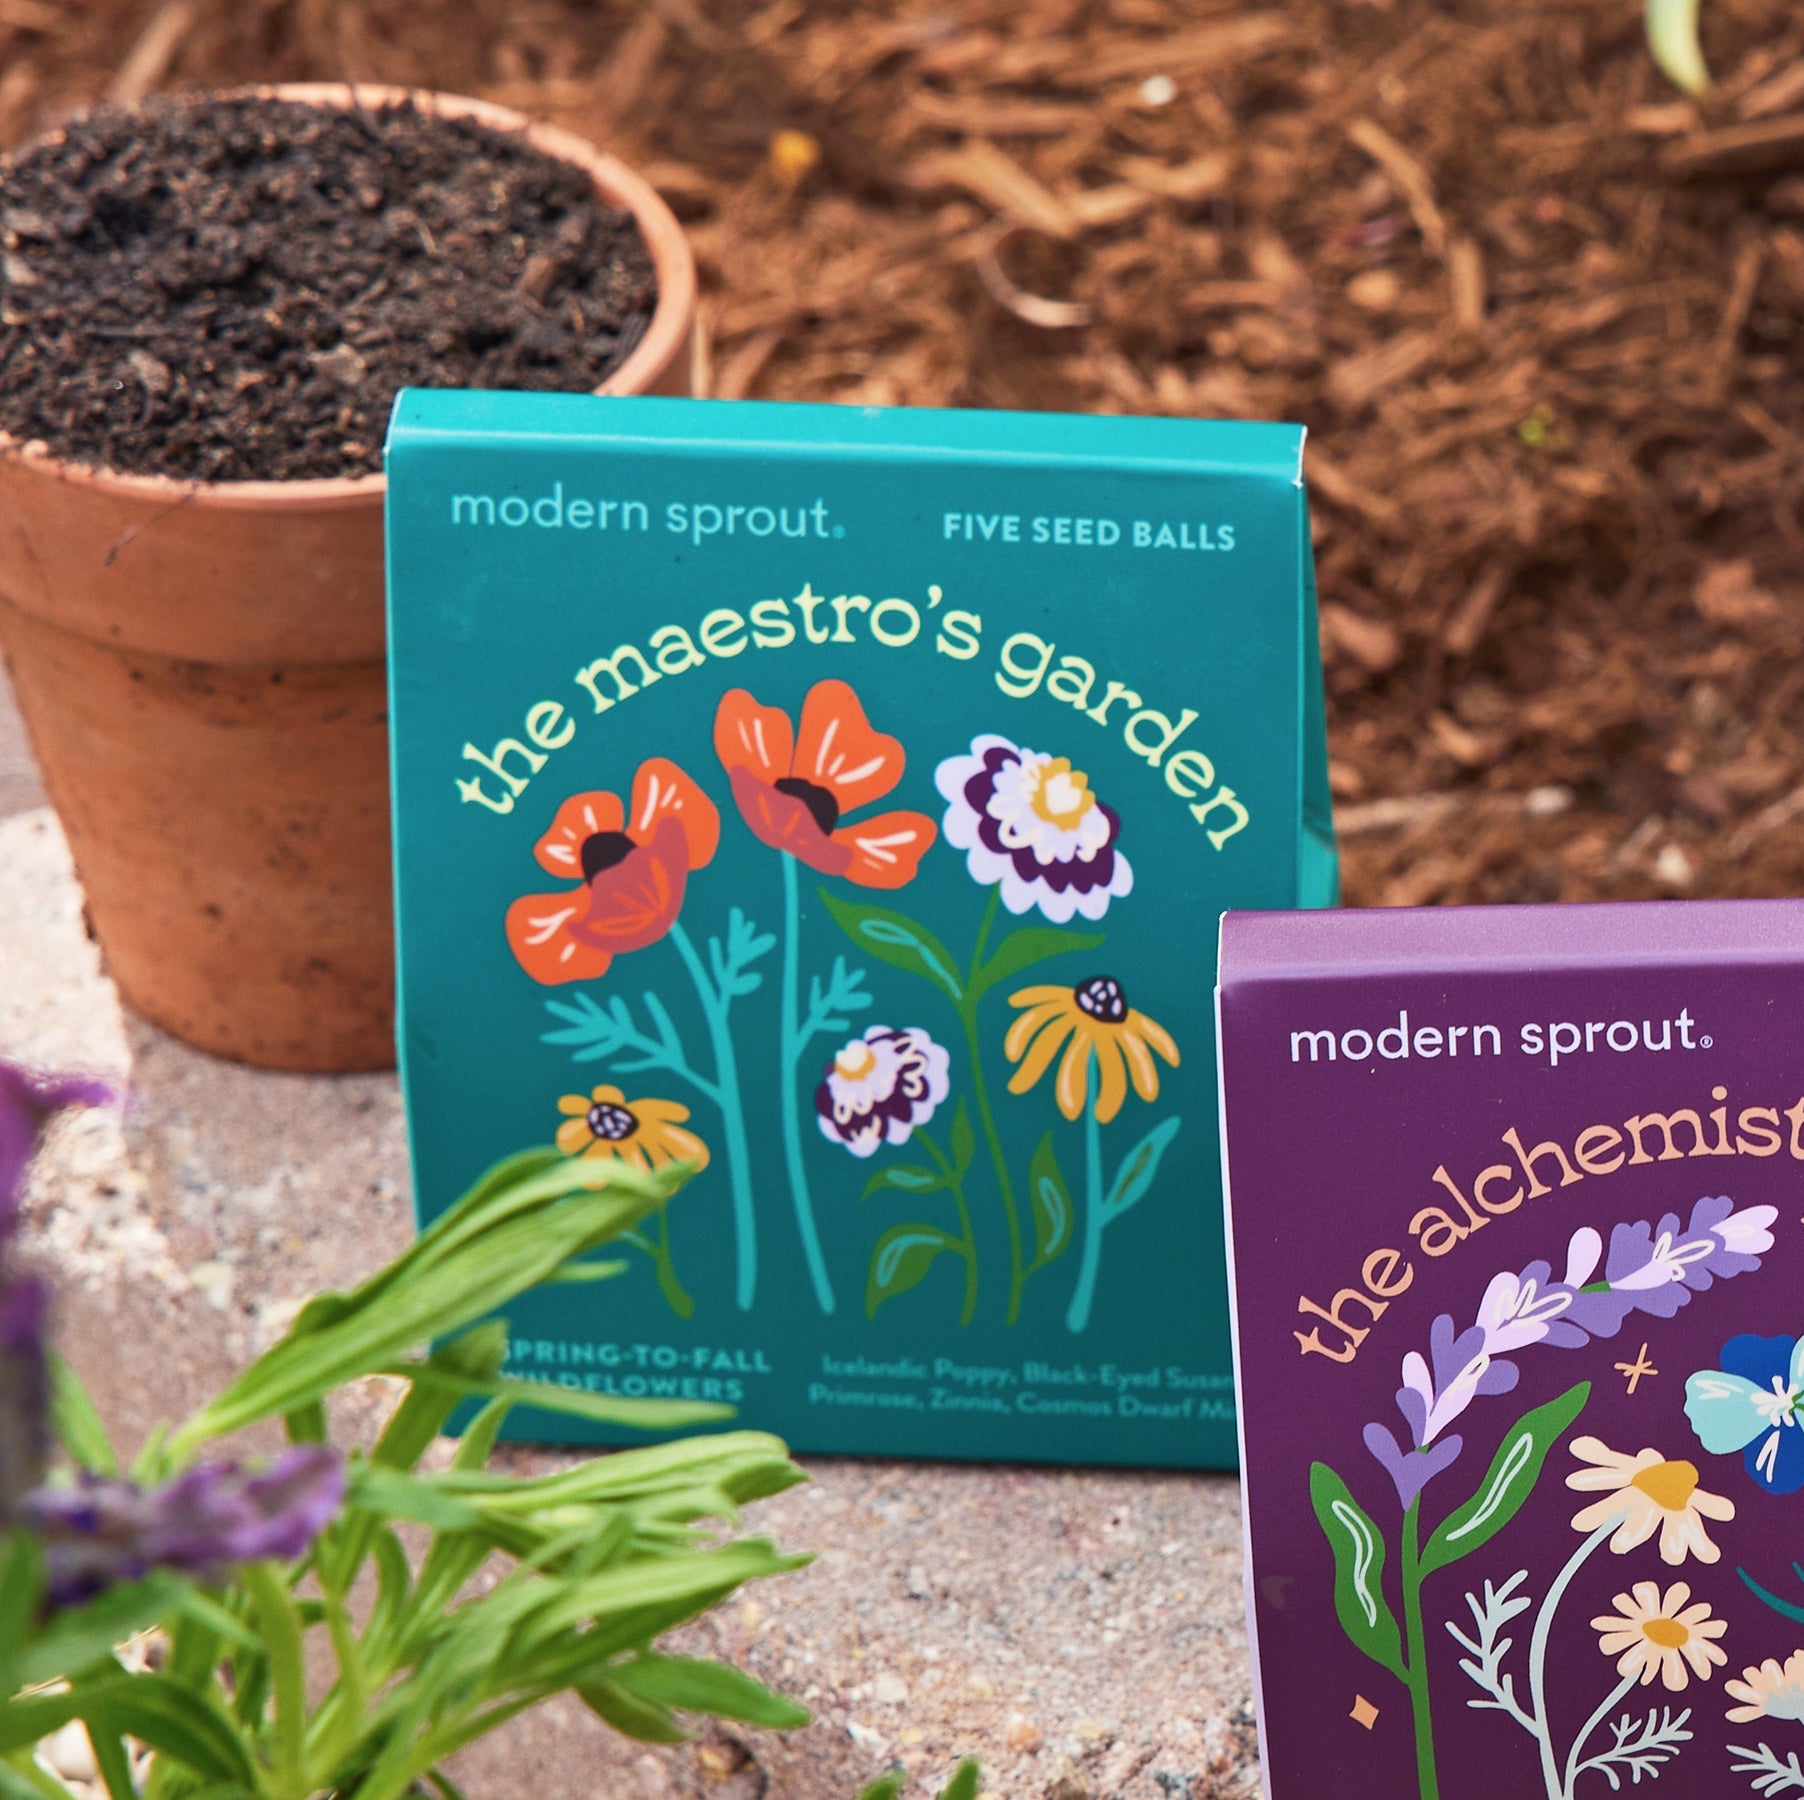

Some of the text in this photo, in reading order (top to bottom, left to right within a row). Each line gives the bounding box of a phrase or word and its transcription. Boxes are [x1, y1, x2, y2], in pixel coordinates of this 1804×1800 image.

[451, 480, 649, 532] modern
[943, 512, 1236, 551] FIVE SEED BALLS
[456, 582, 1250, 852] the maestro’s garden
[1290, 1010, 1501, 1062] modern
[1293, 1249, 1414, 1364] the
[821, 1353, 929, 1381] Icelandic
[933, 1357, 1019, 1388] Poppy,
[1023, 1360, 1160, 1393] Black-Eyed
[1118, 1395, 1194, 1419] Dwarf
